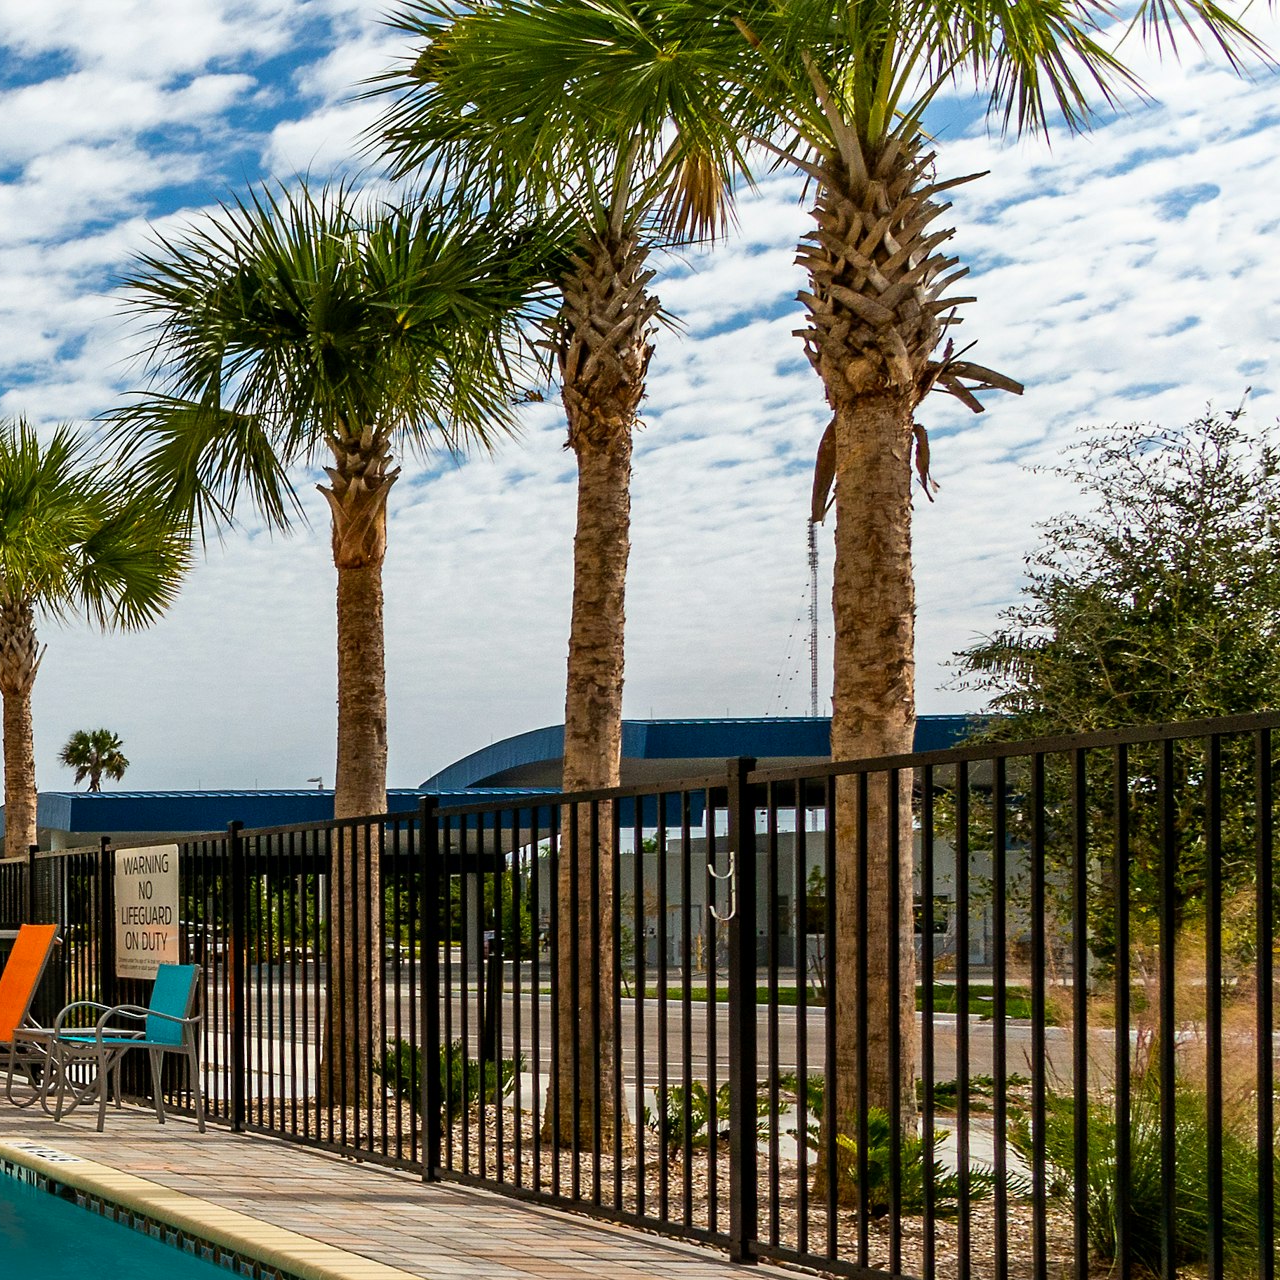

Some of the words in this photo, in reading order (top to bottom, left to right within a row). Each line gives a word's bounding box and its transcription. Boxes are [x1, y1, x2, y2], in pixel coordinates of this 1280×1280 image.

[123, 854, 169, 875] WARNING
[138, 880, 153, 900] NO
[121, 906, 172, 925] LIFEGUARD
[125, 931, 139, 950] ON
[142, 932, 168, 951] DUTY
